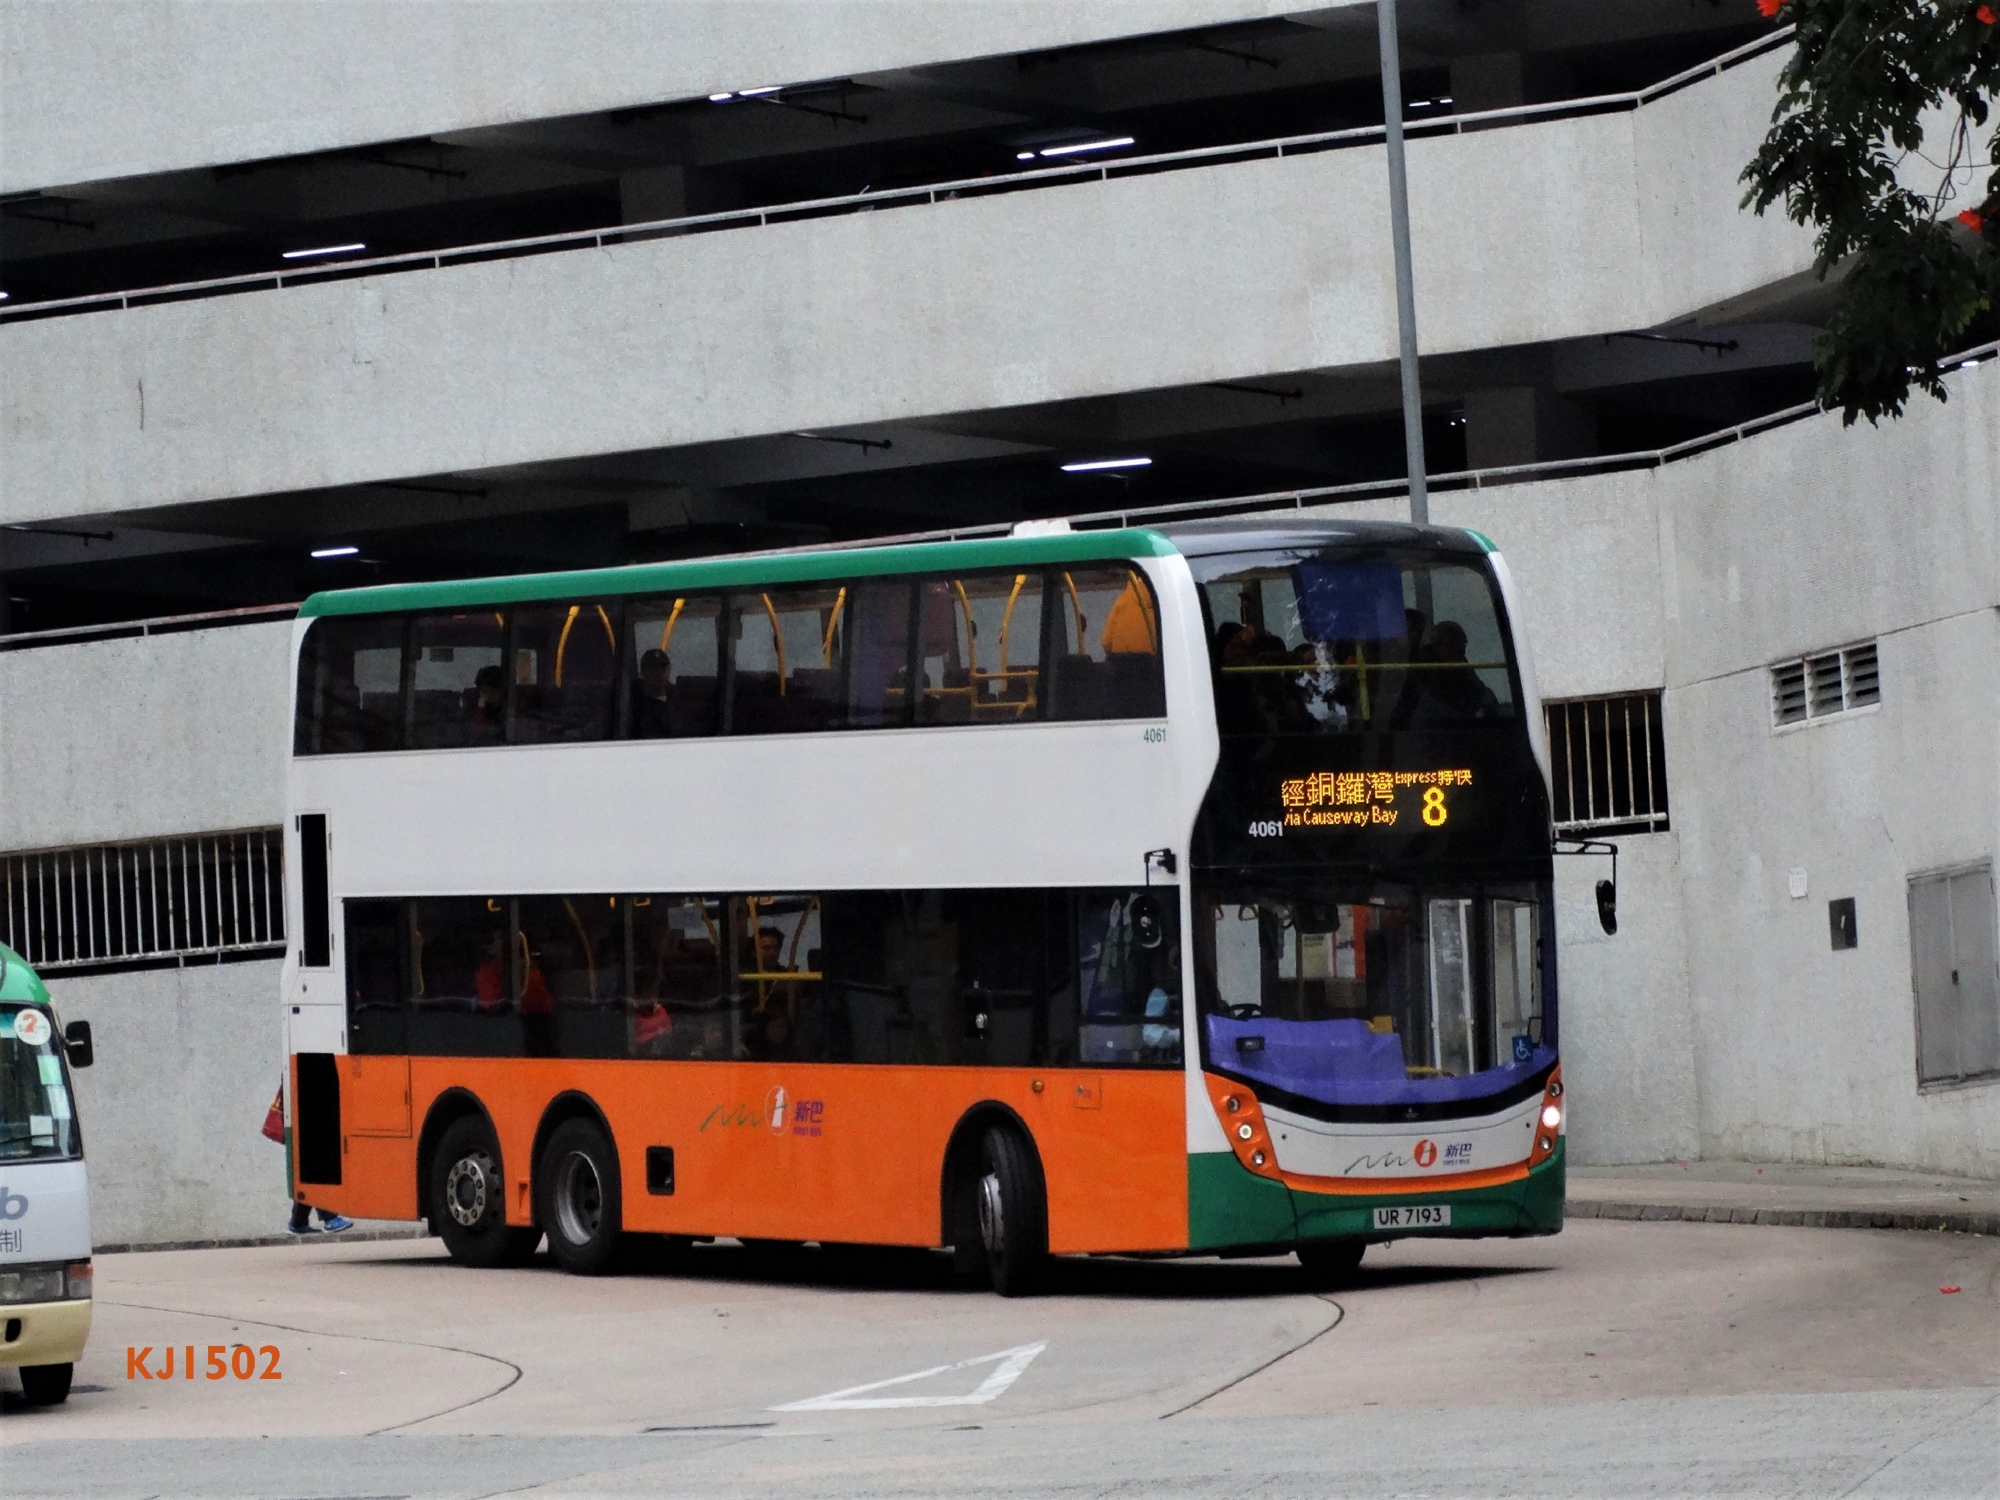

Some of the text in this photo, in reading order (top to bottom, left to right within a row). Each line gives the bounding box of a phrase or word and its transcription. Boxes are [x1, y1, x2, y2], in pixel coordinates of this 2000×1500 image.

[1143, 728, 1166, 743] 4061
[1438, 769, 1472, 786] 特快
[1281, 772, 1394, 807] 經銅鑼灣
[1422, 787, 1447, 827] 8
[1303, 808, 1369, 827] Causeway
[1372, 806, 1398, 826] Bay
[1248, 821, 1283, 837] 4061
[794, 1100, 824, 1123] 新巴
[1444, 1142, 1473, 1158] 新巴
[1379, 1207, 1442, 1225] UR 7193
